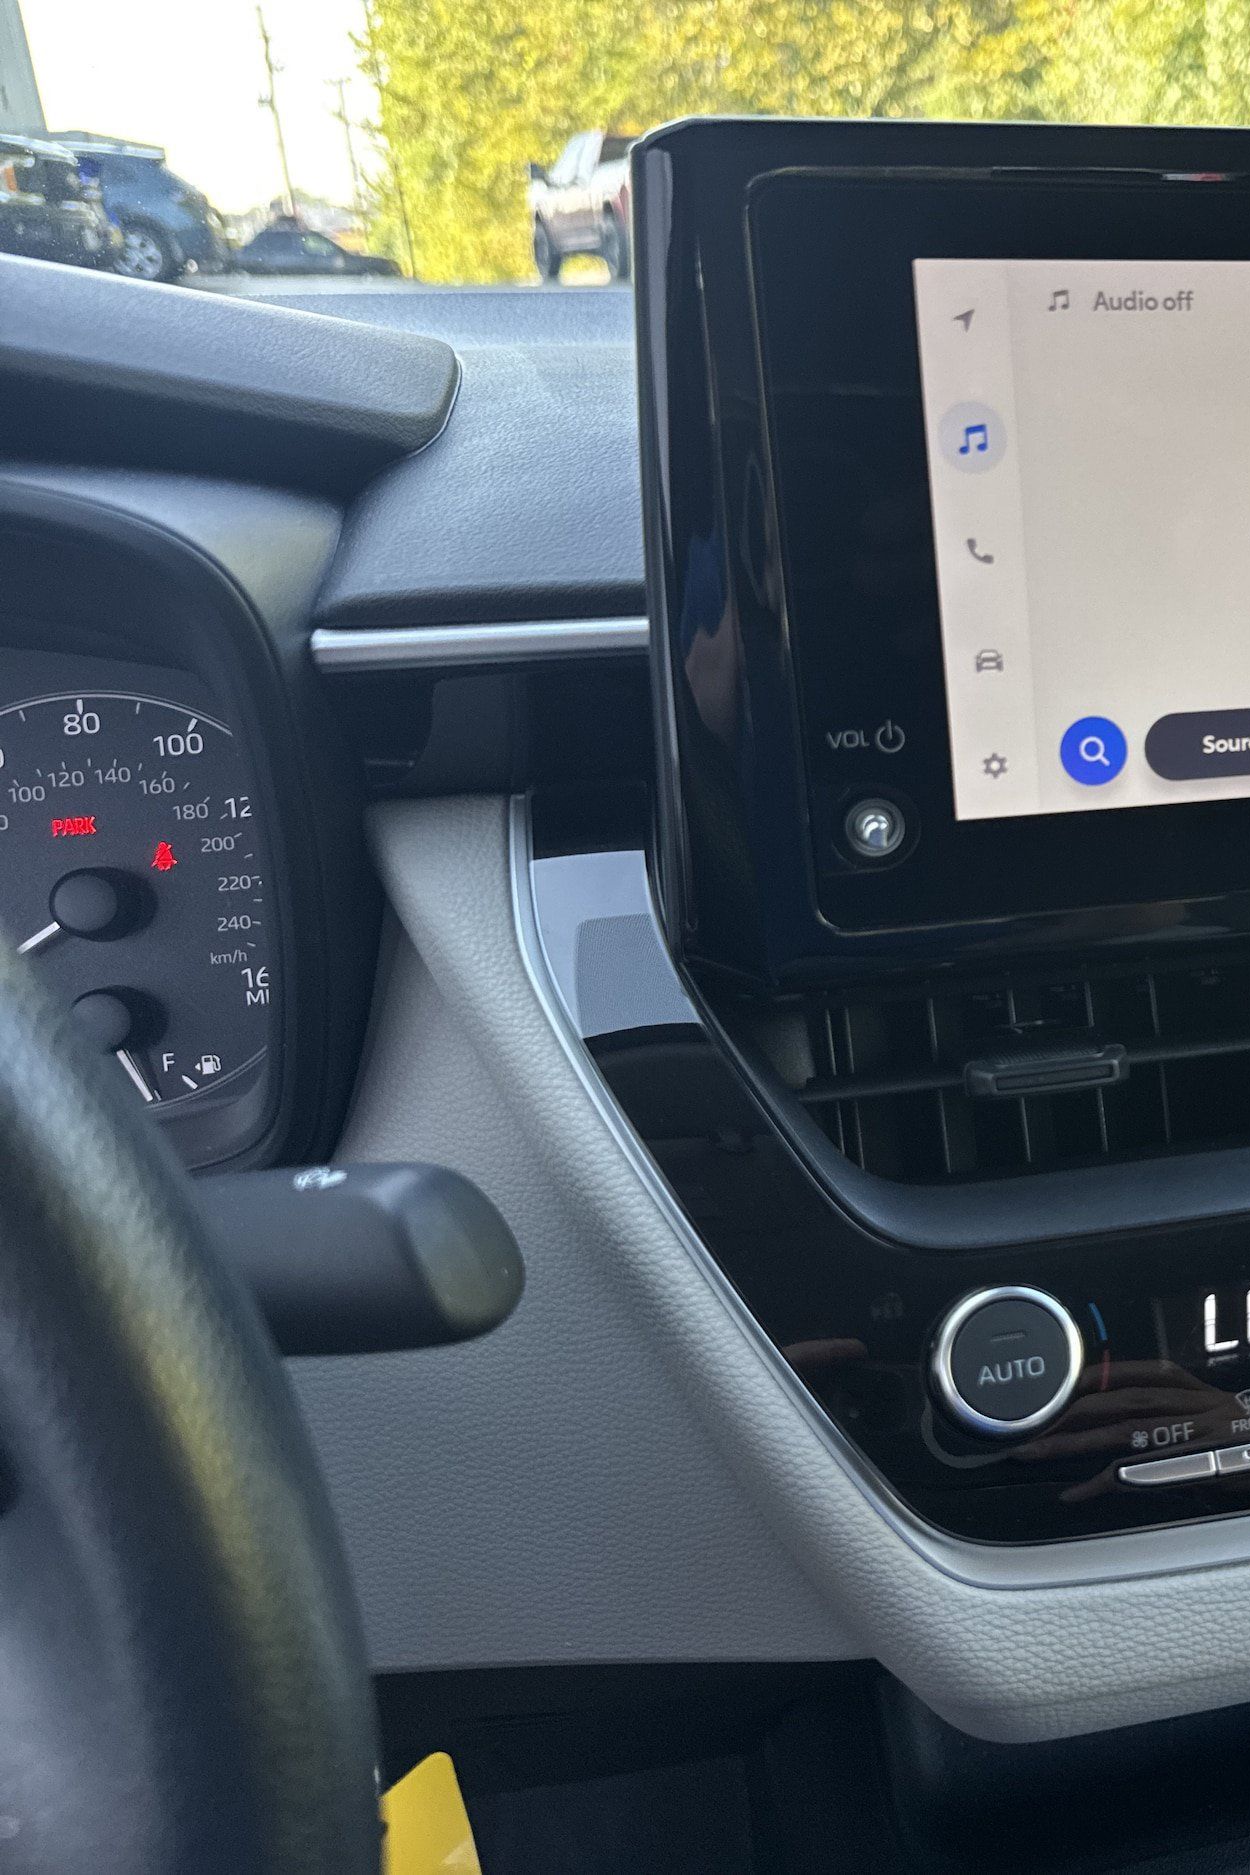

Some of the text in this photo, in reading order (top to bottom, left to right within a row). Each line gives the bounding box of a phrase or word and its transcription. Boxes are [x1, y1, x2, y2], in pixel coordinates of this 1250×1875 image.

[1093, 290, 1194, 312] Audio off
[63, 712, 101, 736] 80
[152, 732, 204, 757] 100
[826, 729, 871, 750] VOL
[47, 770, 85, 788] 120
[94, 767, 132, 785] 140
[8, 785, 46, 803] 100
[139, 777, 176, 795] 160
[172, 803, 209, 820] 180
[51, 816, 97, 838] PARK
[201, 836, 235, 853] 200
[217, 875, 252, 892] 220
[217, 915, 252, 932] 240
[209, 949, 248, 965] km/h
[162, 1052, 176, 1072] F
[979, 1355, 1046, 1386] AUTO
[1152, 1421, 1195, 1446] OFF
